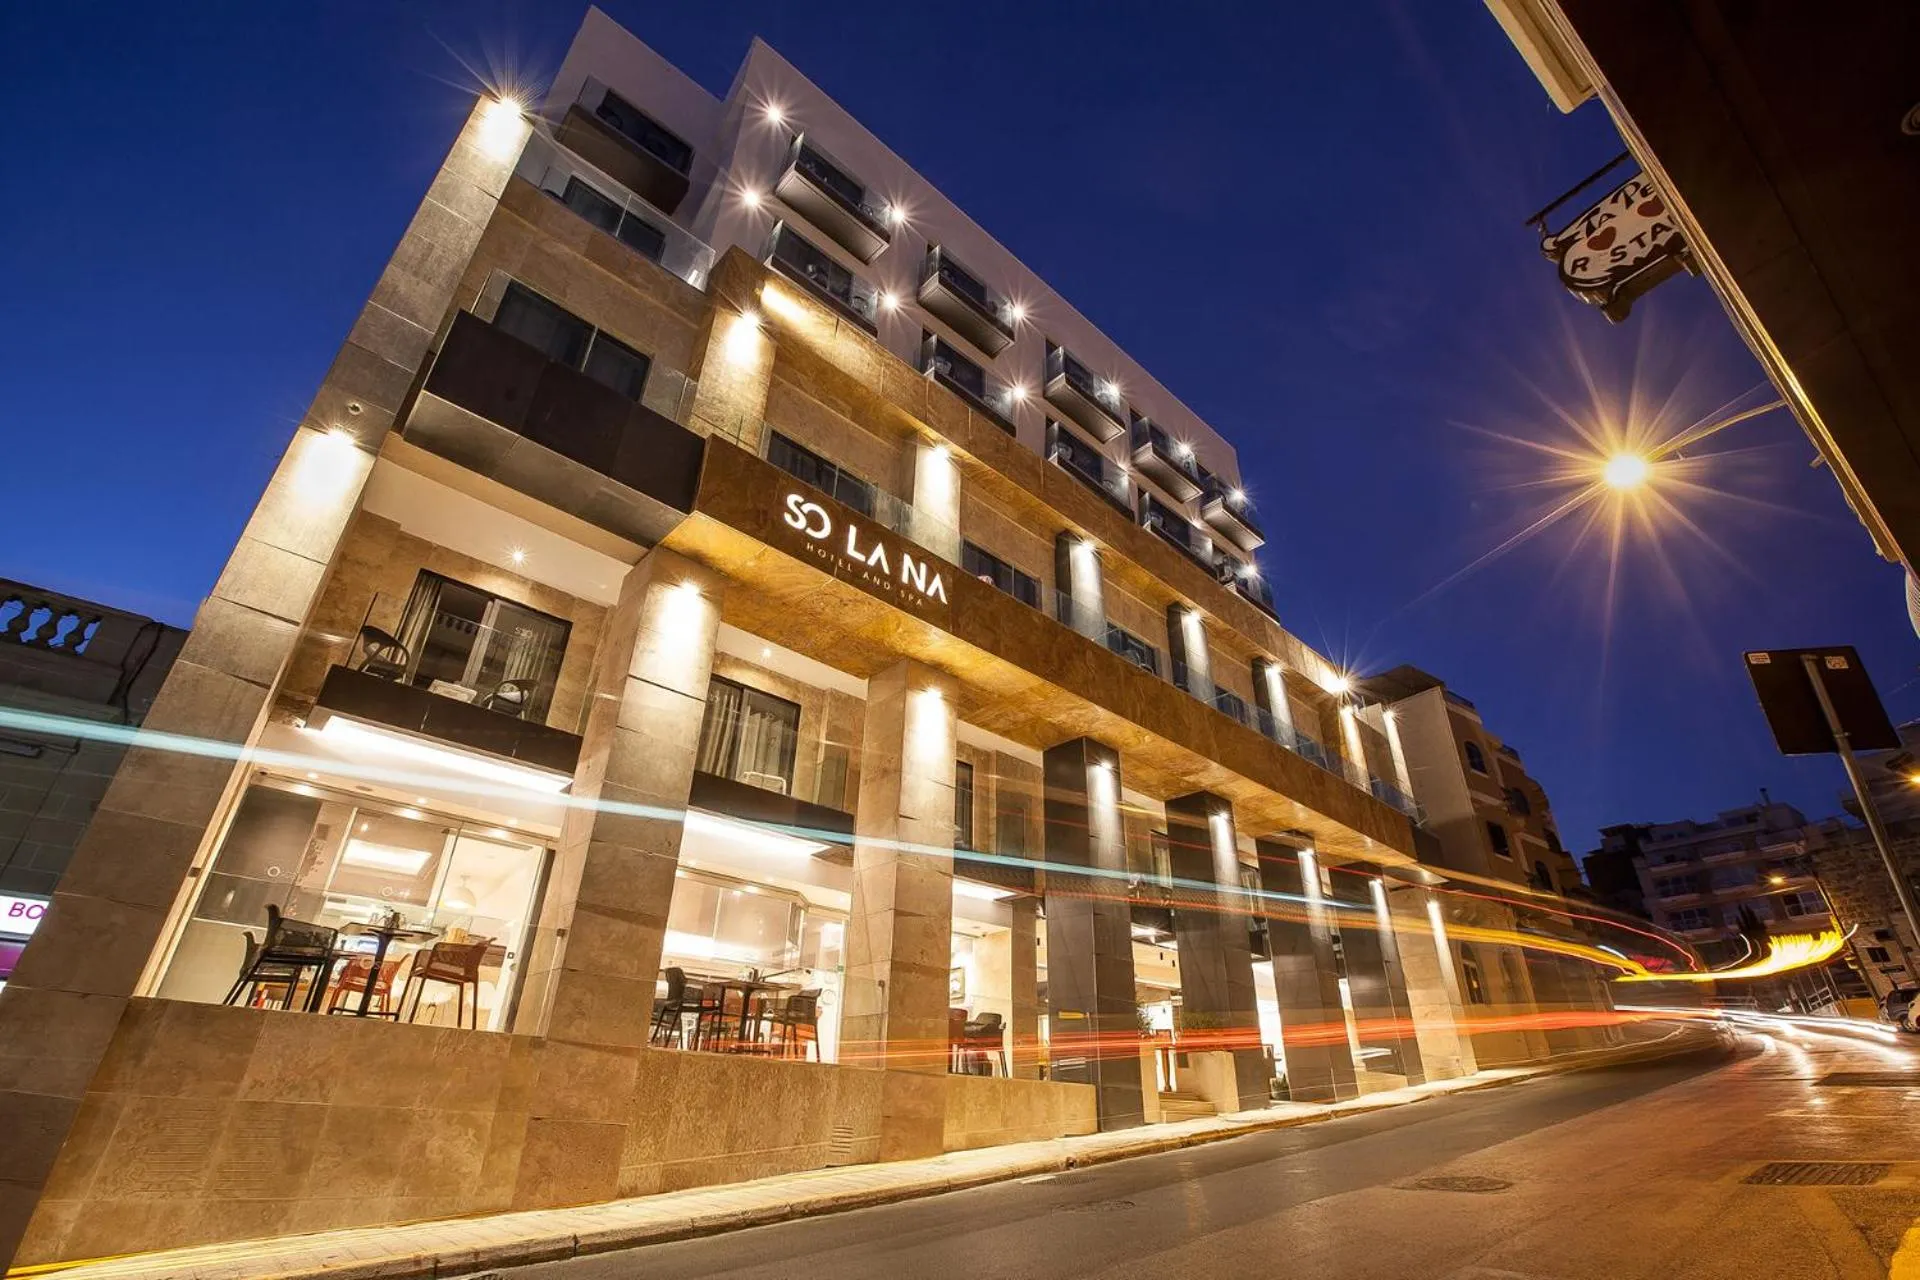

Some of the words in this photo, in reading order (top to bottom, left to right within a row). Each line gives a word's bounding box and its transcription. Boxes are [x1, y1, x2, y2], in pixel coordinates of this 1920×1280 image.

[1570, 214, 1677, 275] RSTA
[806, 542, 853, 572] HOTEL
[862, 571, 892, 591] AND
[899, 590, 924, 607] SPA
